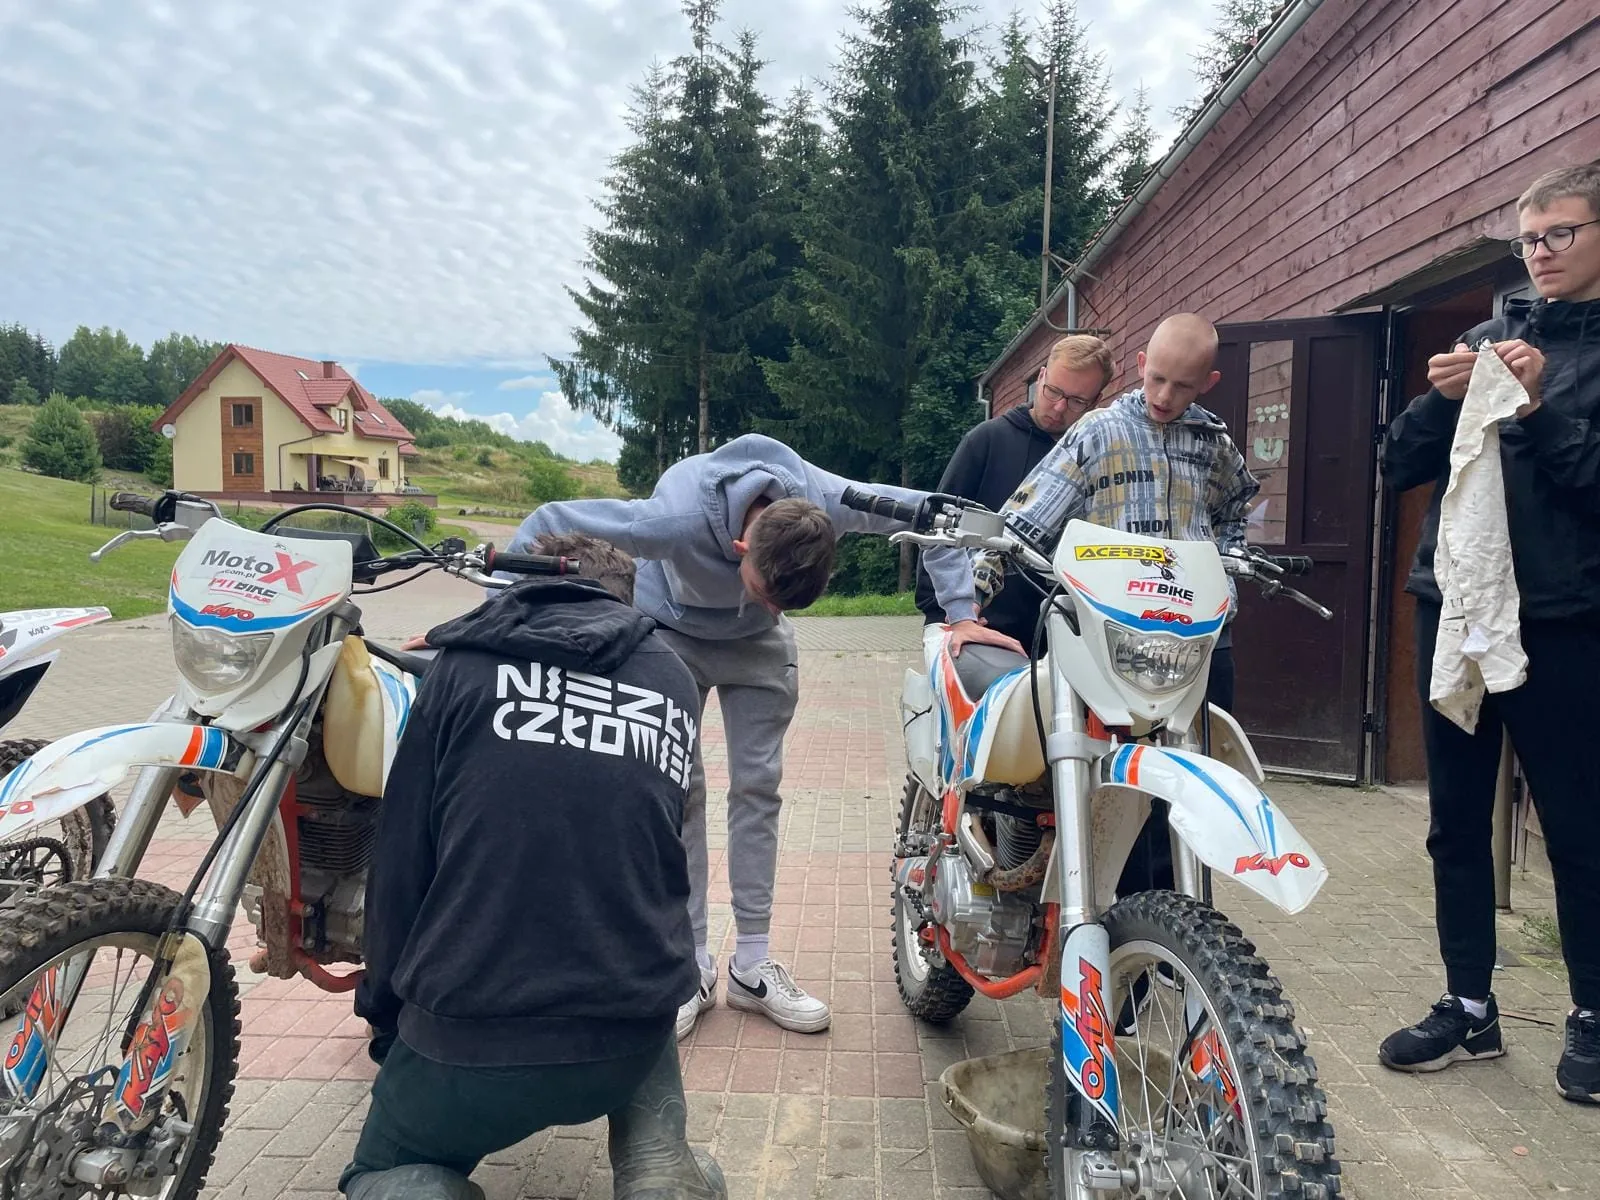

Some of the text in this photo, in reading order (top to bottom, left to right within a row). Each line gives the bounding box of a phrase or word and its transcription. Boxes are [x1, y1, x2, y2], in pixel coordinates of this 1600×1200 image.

[1114, 470, 1155, 487] KING
[1127, 580, 1195, 602] PITBIKE
[1140, 607, 1193, 625] KAYO
[1234, 852, 1311, 877] KAYO
[1075, 955, 1112, 1101] KAYO
[121, 976, 185, 1120] KAYO
